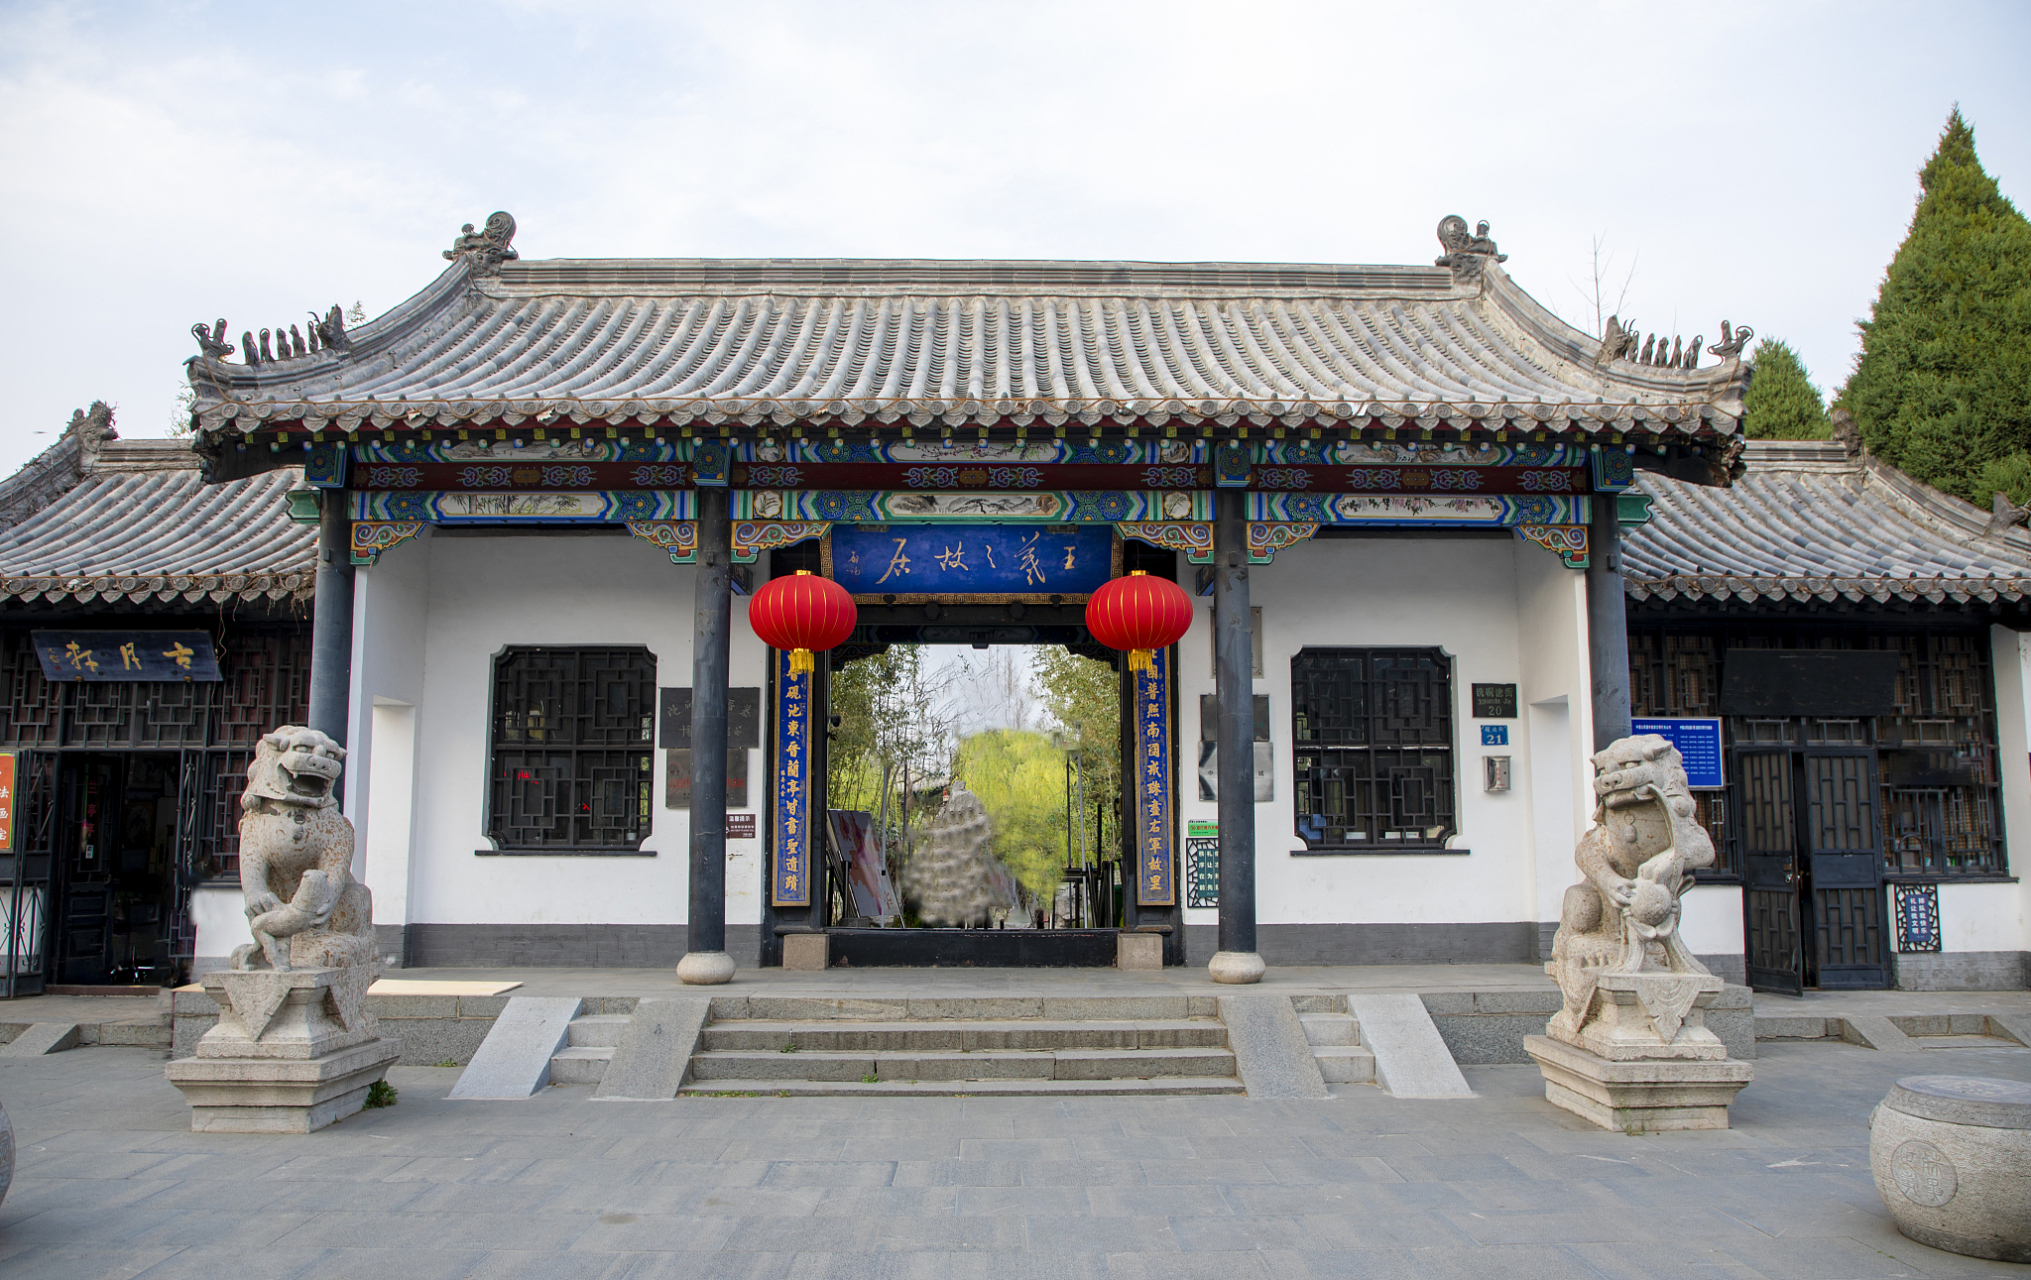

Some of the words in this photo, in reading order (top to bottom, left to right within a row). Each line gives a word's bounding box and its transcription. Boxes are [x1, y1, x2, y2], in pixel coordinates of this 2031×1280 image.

[875, 531, 1076, 586] 王羲之故居
[1488, 705, 1502, 716] 20
[1486, 734, 1503, 745] 21
